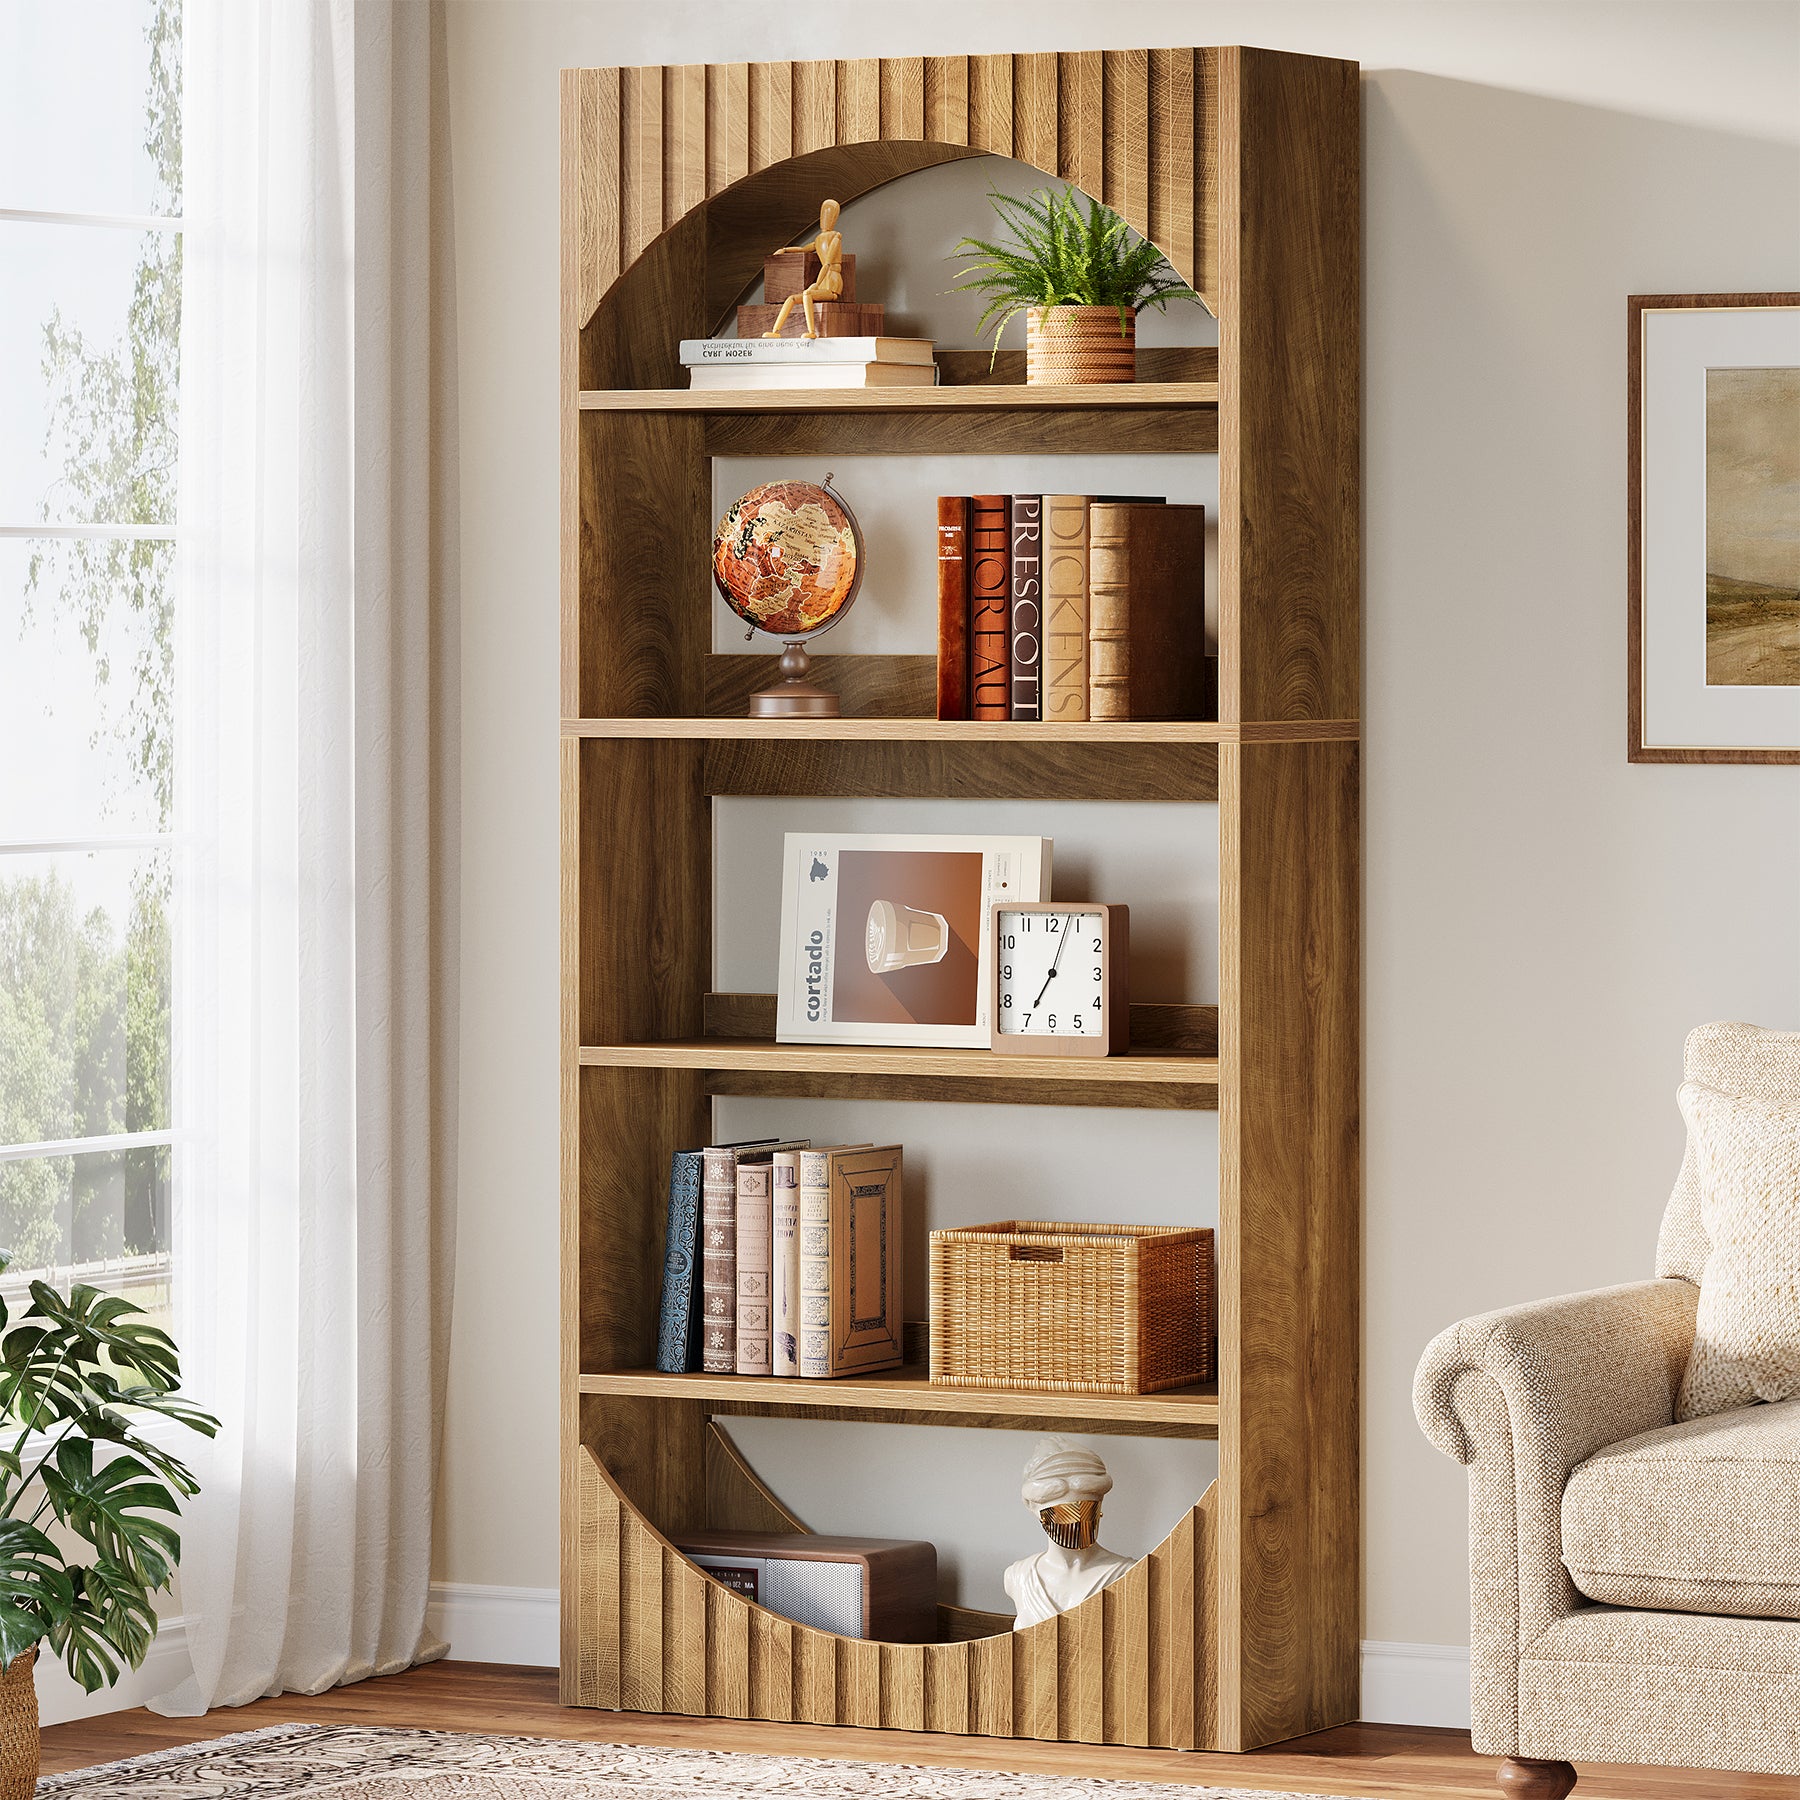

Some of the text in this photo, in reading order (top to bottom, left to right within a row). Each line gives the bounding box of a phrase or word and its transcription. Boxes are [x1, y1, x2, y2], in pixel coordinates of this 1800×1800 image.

[974, 497, 1006, 709] THOREAU
[1013, 498, 1040, 719] PRESCOTT
[1049, 506, 1085, 713] DICKENS
[1022, 917, 1080, 933] 11 12 1
[1003, 934, 1102, 953] 10 2
[805, 930, 823, 1022] cortado
[1003, 965, 1102, 981] 9 3
[1003, 994, 1102, 1010] 8 4
[1022, 1013, 1083, 1029] 7 6 5
